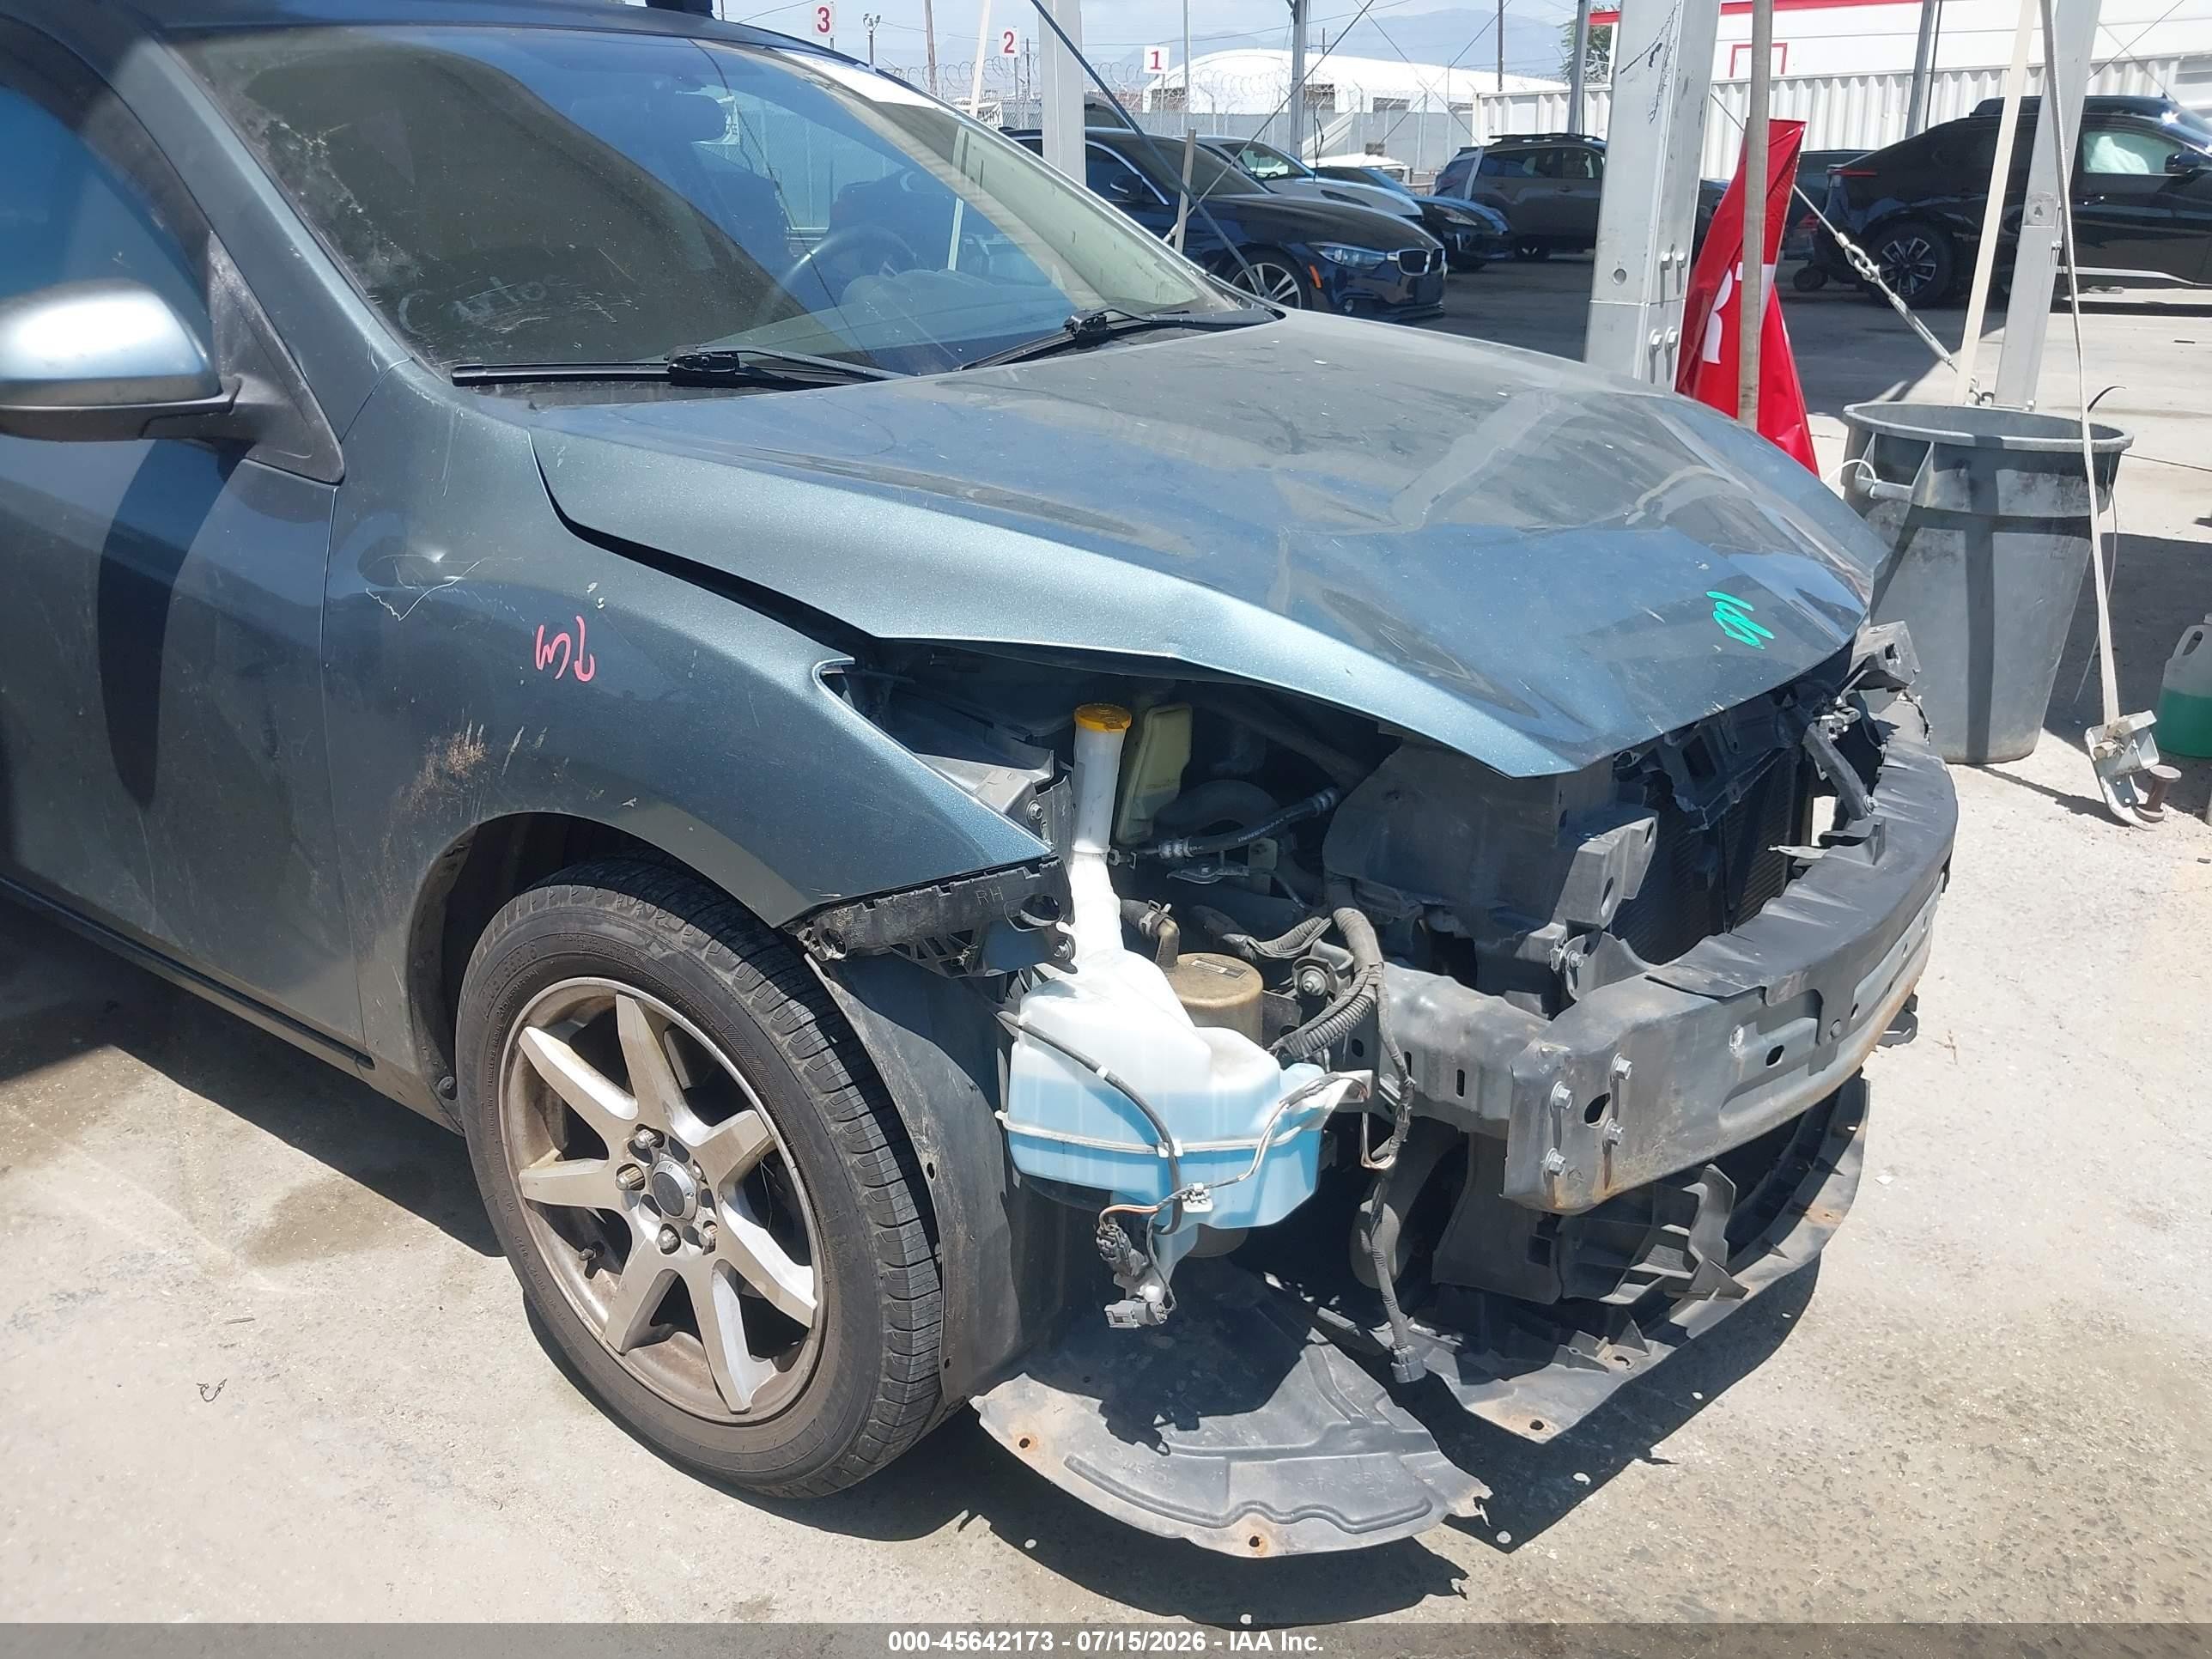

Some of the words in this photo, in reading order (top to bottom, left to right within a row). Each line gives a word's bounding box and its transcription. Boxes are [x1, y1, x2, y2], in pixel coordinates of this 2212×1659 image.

[817, 6, 830, 33] 3
[1003, 31, 1015, 54] 2
[1150, 50, 1162, 70] 1
[975, 885, 1005, 908] RH
